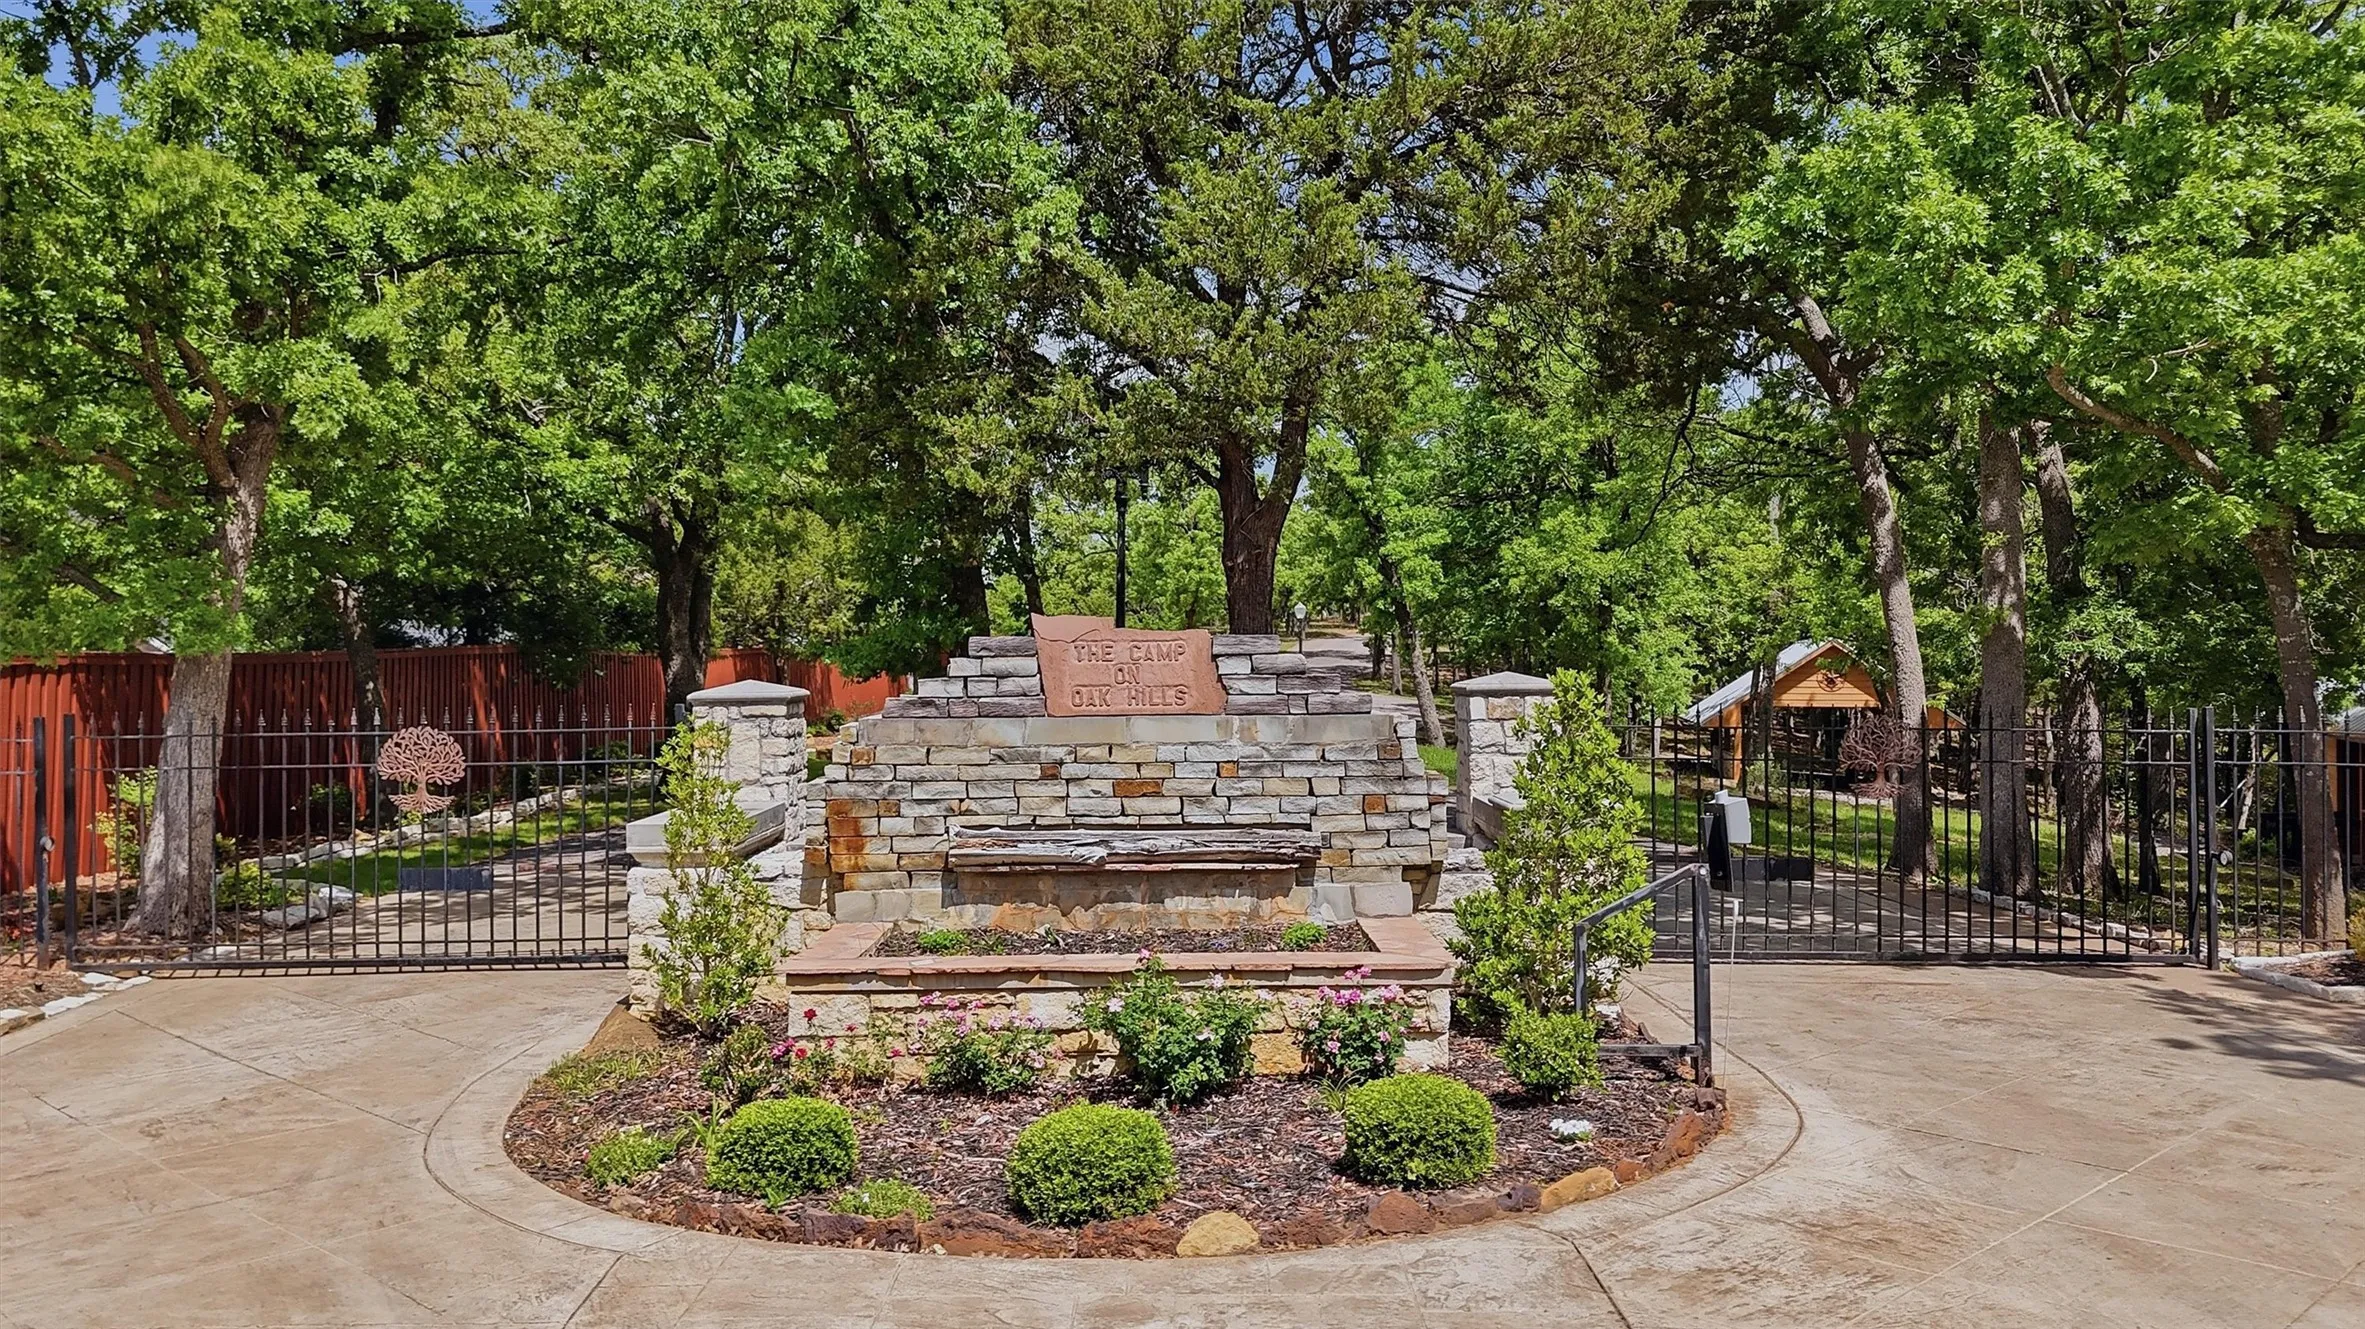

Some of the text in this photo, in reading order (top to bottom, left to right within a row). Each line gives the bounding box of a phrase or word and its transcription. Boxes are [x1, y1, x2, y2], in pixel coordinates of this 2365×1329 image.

[1074, 642, 1187, 662] THE CAMP
[1114, 664, 1141, 685] ON
[1071, 686, 1189, 707] OAK HILLS
